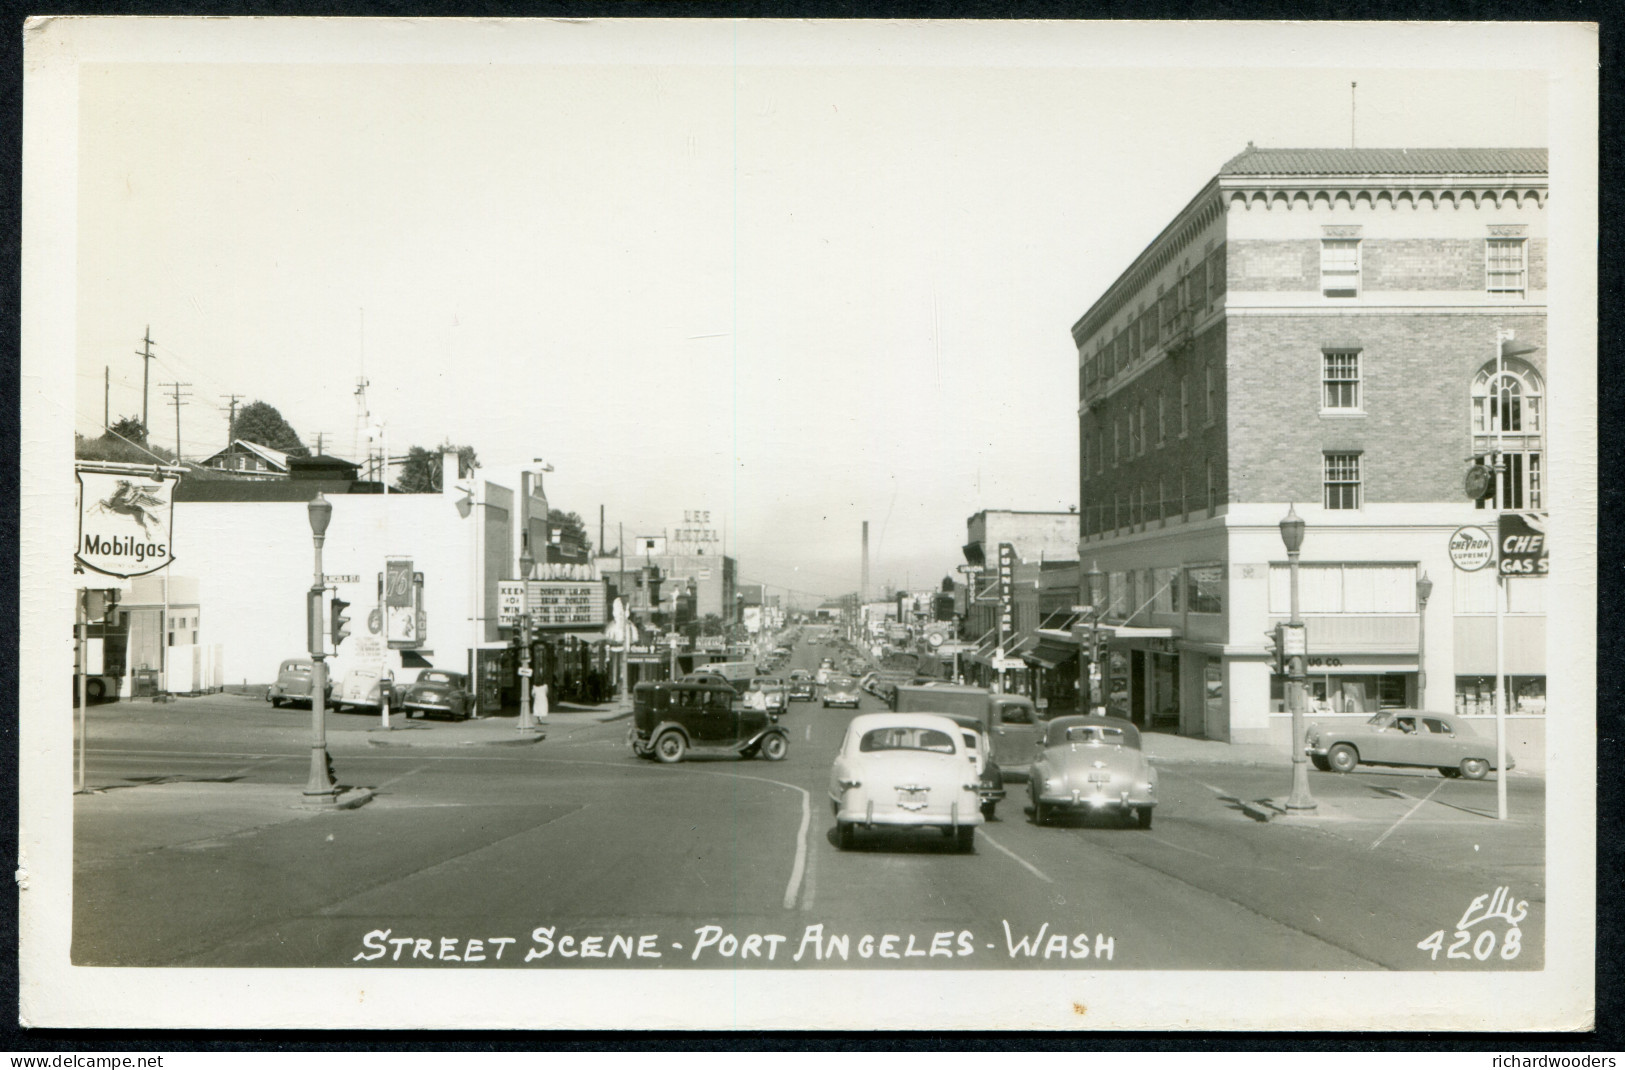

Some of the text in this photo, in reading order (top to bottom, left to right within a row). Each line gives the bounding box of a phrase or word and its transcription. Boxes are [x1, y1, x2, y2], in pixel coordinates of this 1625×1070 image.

[684, 510, 710, 523] LEE
[674, 529, 719, 542] HOTEL
[84, 534, 166, 563] Mobilgas
[1450, 539, 1490, 551] CHEVRON
[1454, 551, 1488, 560] SUPREME
[1501, 558, 1533, 573] GAS
[503, 606, 520, 614] WIN
[553, 606, 571, 614] LUCKY
[1326, 658, 1343, 667] CO.
